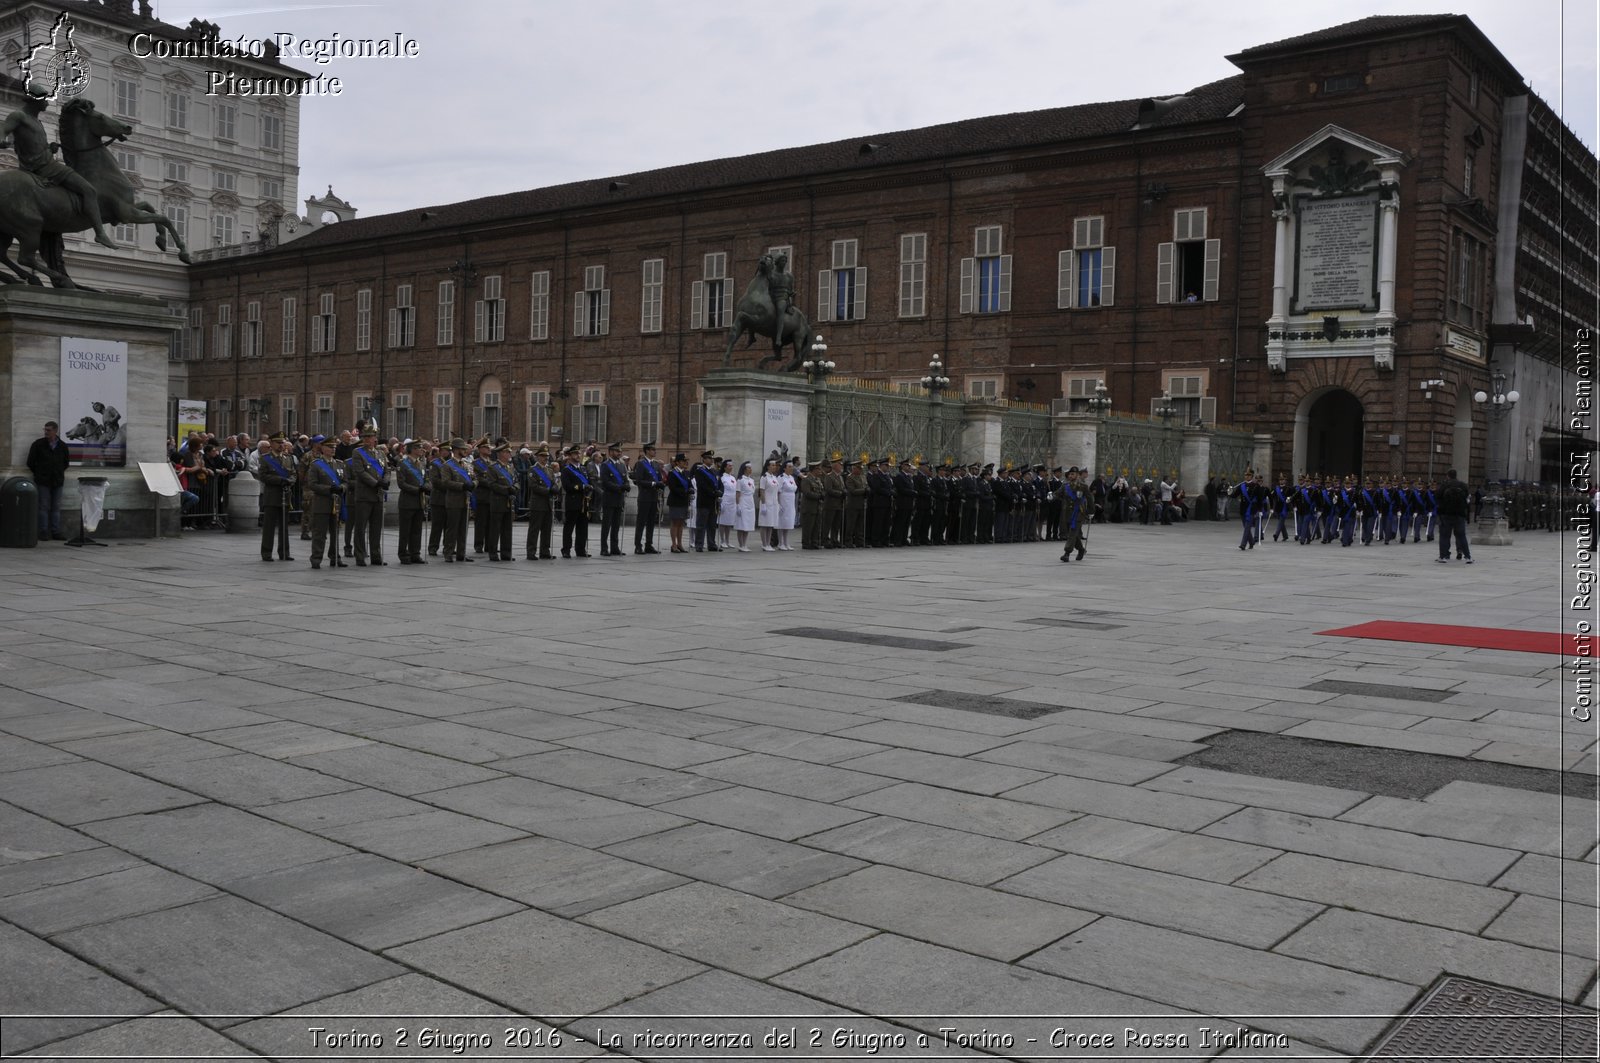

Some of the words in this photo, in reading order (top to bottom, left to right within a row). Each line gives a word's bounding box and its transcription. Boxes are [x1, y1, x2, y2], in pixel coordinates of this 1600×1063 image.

[68, 350, 94, 360] POLO
[95, 352, 120, 363] REALE
[68, 360, 106, 371] TORINO
